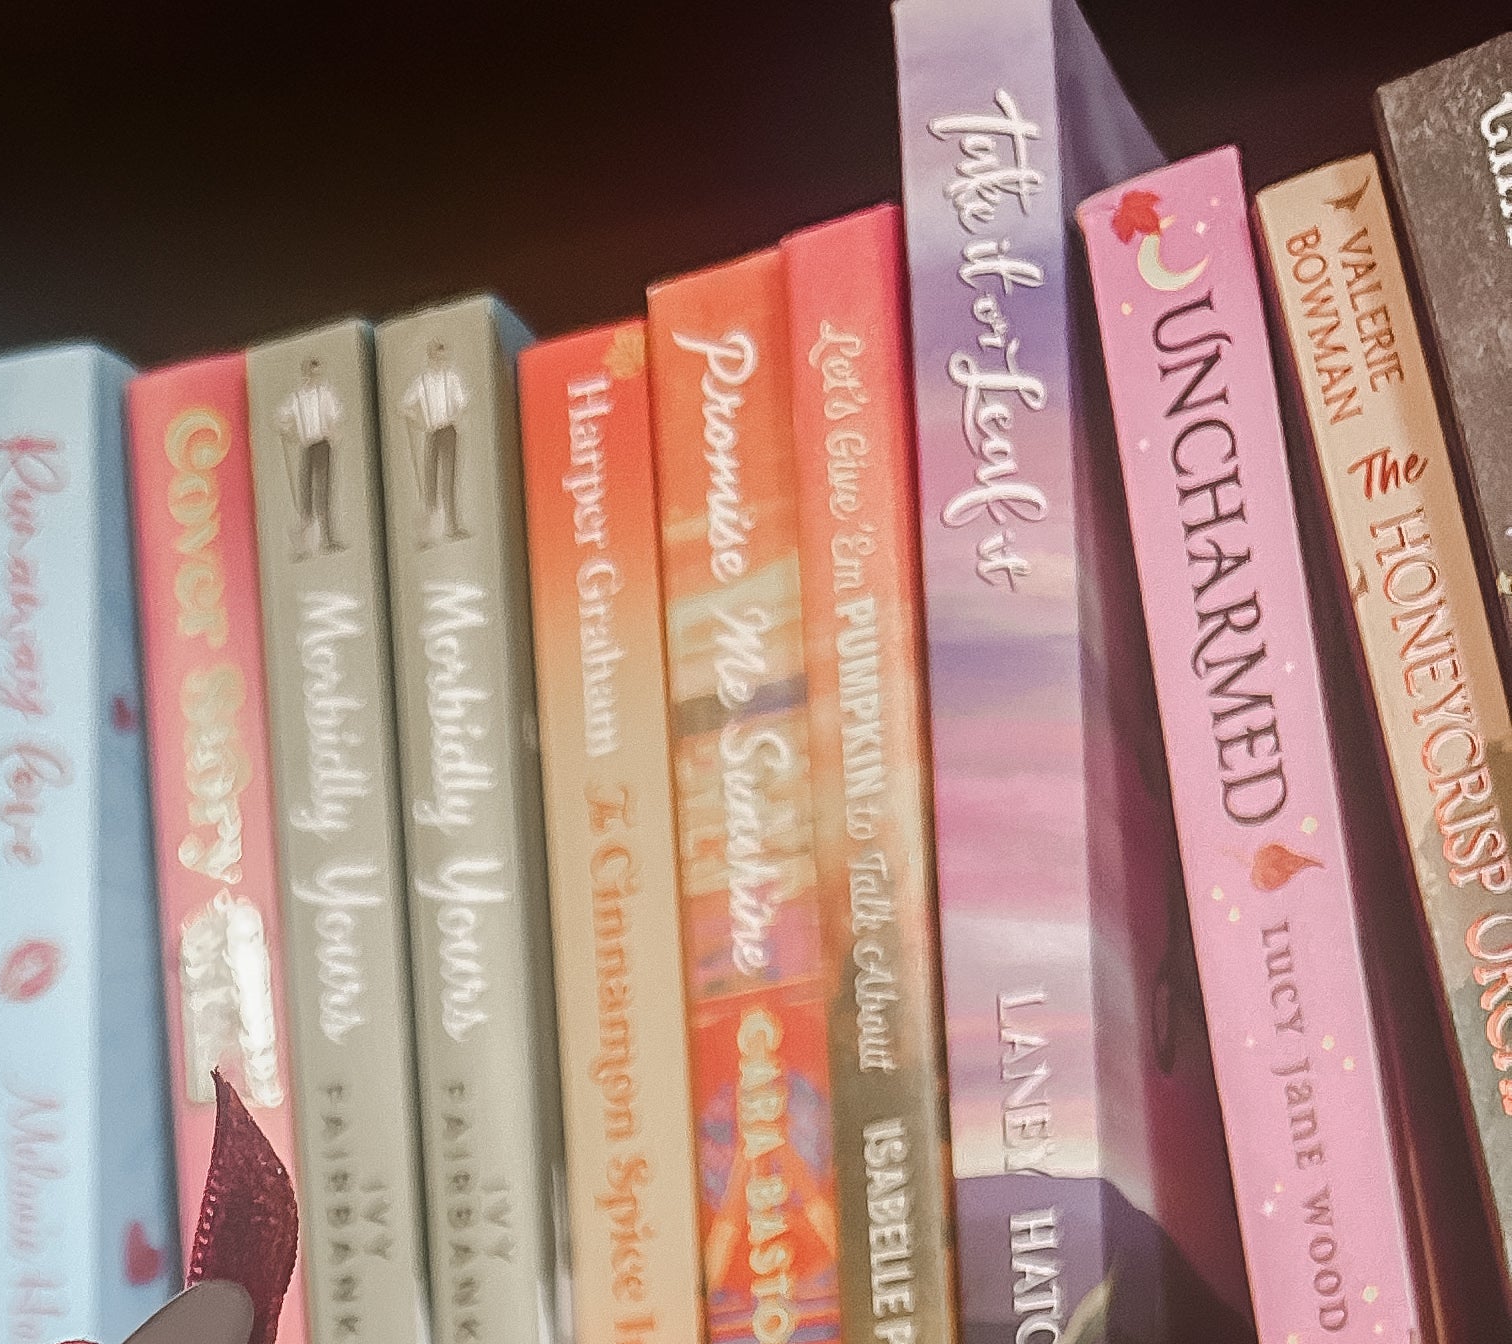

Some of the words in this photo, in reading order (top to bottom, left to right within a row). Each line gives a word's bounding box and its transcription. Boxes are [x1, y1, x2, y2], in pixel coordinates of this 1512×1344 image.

[926, 87, 1042, 234] Take
[959, 240, 1044, 295] it
[971, 296, 1019, 350] or
[1285, 226, 1366, 427] BOWMAN
[1335, 226, 1404, 393] VALERIE
[672, 329, 759, 584] Promise
[806, 319, 870, 422] Let's
[939, 340, 1048, 528] Leaf
[163, 407, 231, 647] Cover
[565, 373, 612, 549] Harper
[822, 427, 870, 519] Give
[1346, 446, 1430, 500] The
[974, 528, 1034, 591] it
[1148, 293, 1286, 828] UNCHARMED
[291, 593, 372, 839] Morbidly
[412, 582, 496, 837] Morbidly
[574, 559, 626, 760] Graham
[713, 603, 769, 703] Me
[835, 598, 887, 801] PUMPKIN
[1368, 505, 1512, 889] HONEYCRISP
[719, 722, 794, 975] Sunshine
[842, 801, 874, 842] to
[850, 850, 891, 937] Talk
[291, 863, 381, 1046] Yours
[414, 857, 504, 1042] Yours
[587, 842, 638, 1144] Cinnamon
[851, 938, 899, 1073] About
[735, 1006, 786, 1163] CARA
[997, 989, 1051, 1175] LANEY
[593, 1157, 656, 1306] Spice
[862, 1117, 919, 1320] ISABELLE
[1299, 1186, 1352, 1335] WOOD
